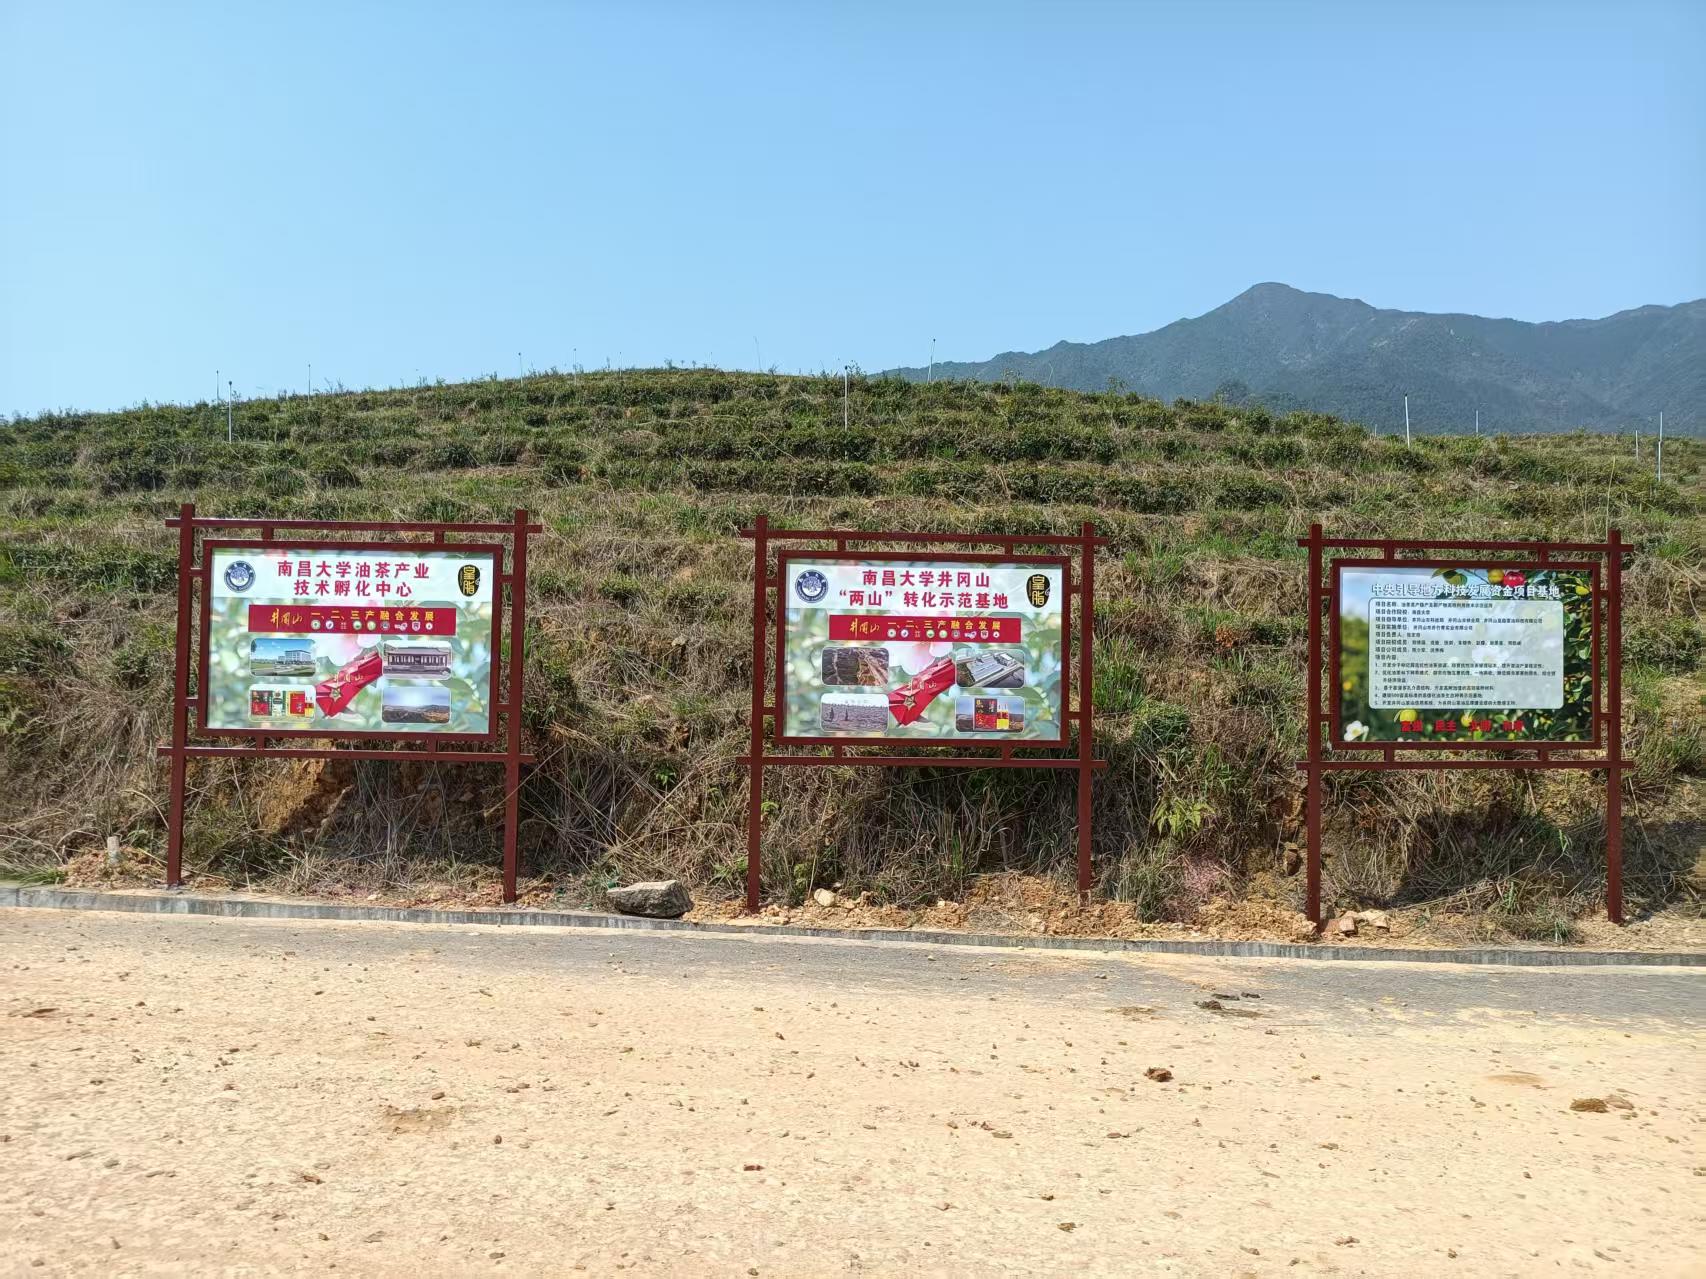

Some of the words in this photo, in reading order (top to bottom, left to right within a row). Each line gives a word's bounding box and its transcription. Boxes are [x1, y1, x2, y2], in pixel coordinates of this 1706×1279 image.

[277, 560, 430, 579] 南昌大学油茶产业
[862, 570, 990, 588] 南昌大学井冈山
[294, 579, 412, 598] 技术孵化中心
[1372, 583, 1561, 598] 中央引导地方科技发展资金项目基地
[311, 610, 434, 622] 一、二、三产融合发展
[887, 620, 1001, 631] 一、二、三产融合发展
